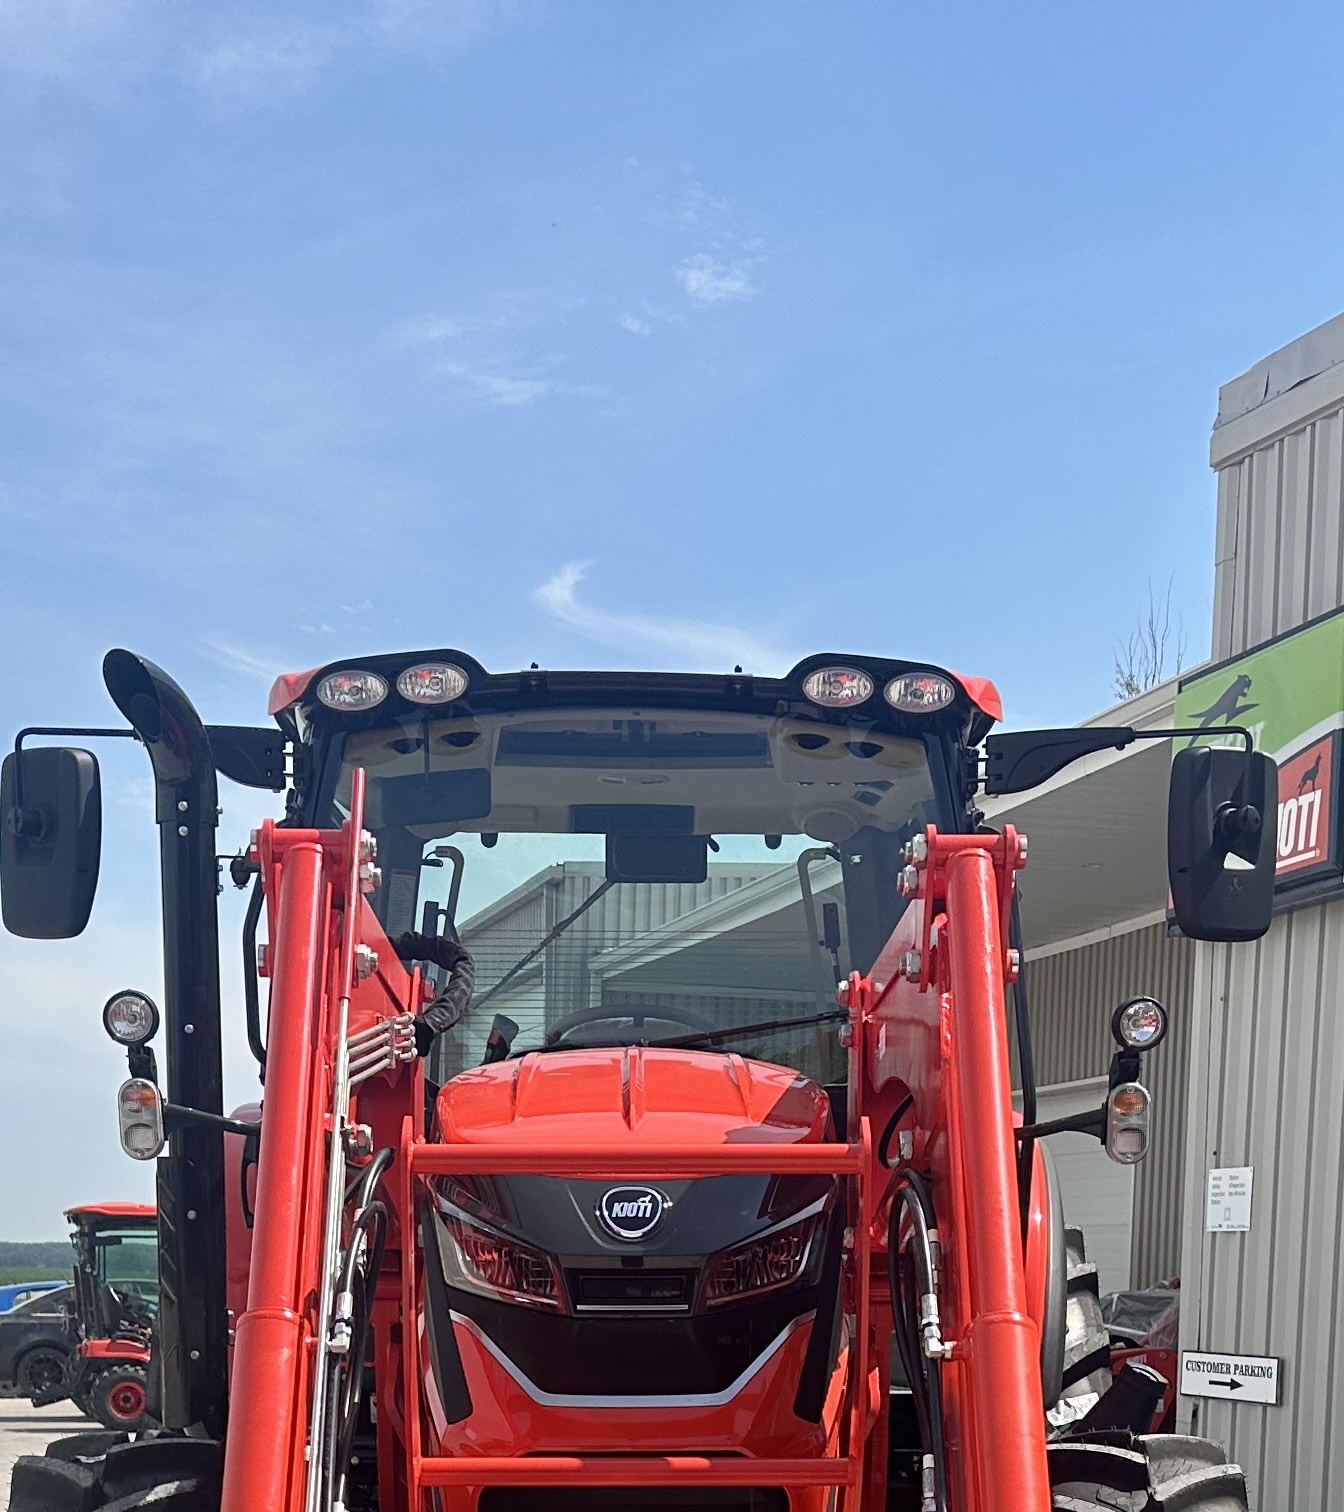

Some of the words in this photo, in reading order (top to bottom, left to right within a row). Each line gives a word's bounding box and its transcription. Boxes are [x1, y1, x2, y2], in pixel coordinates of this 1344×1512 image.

[1277, 789, 1322, 857] IOTI
[611, 1202, 653, 1218] KIOTI
[1185, 1360, 1232, 1375] CUSTOMER
[1233, 1363, 1273, 1379] PARKING
